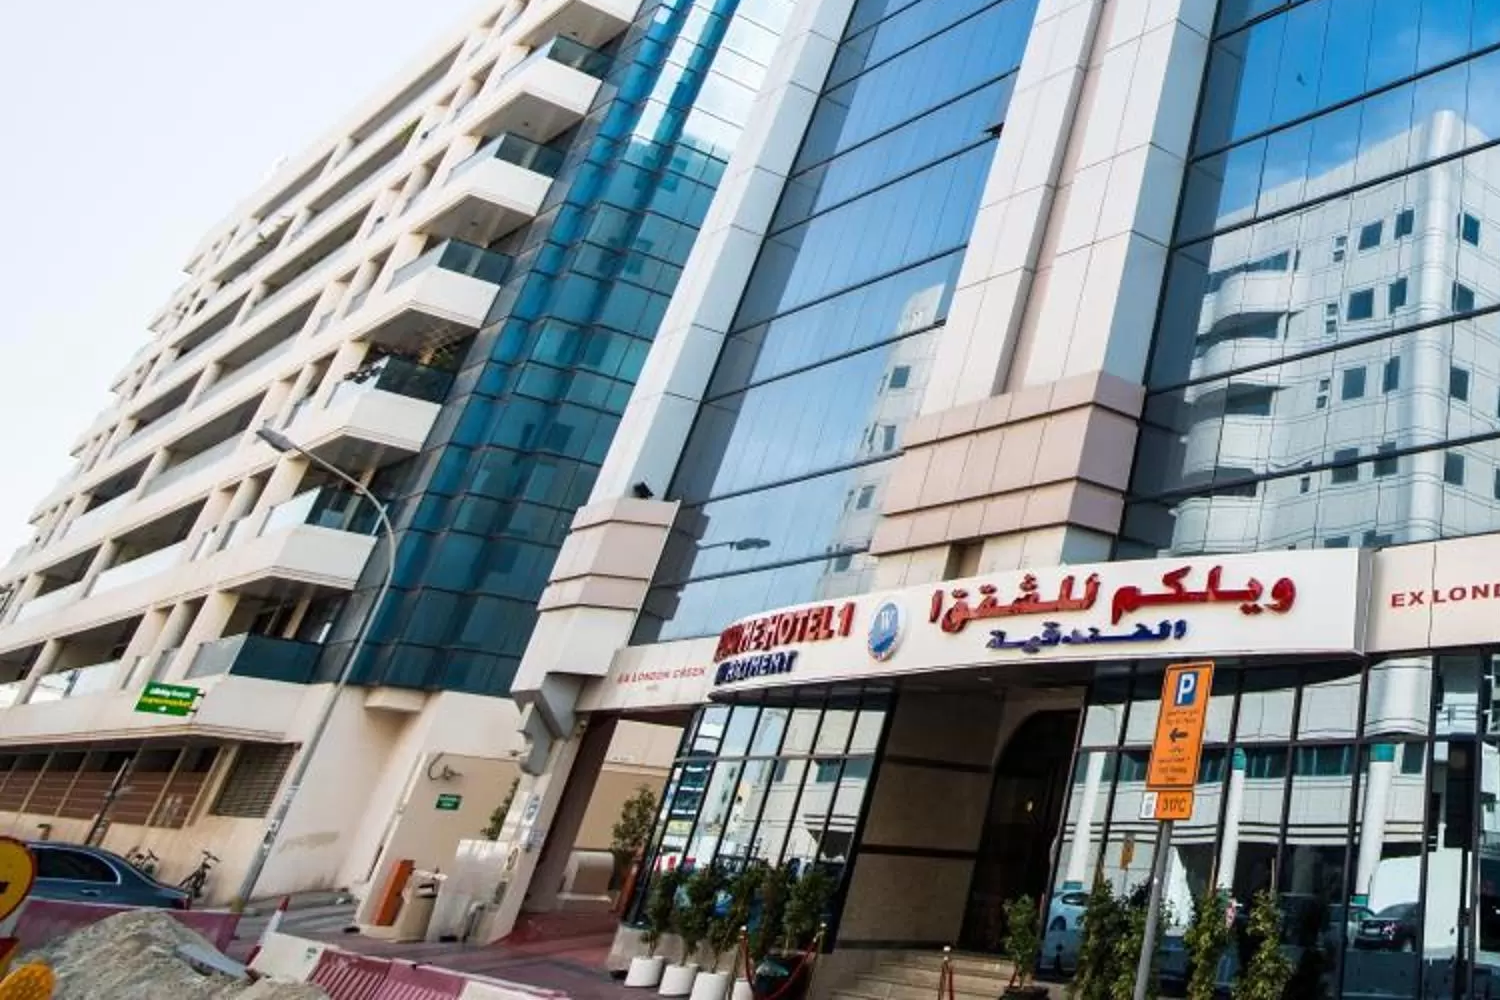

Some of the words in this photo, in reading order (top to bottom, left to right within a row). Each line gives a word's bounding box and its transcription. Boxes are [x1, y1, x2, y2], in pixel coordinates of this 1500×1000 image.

[941, 572, 1100, 634] للشقق
[1111, 565, 1297, 625] ويلكم
[1391, 590, 1425, 608] EX
[767, 605, 835, 652] HOTEL
[838, 601, 855, 637] 1
[1177, 673, 1195, 704] P
